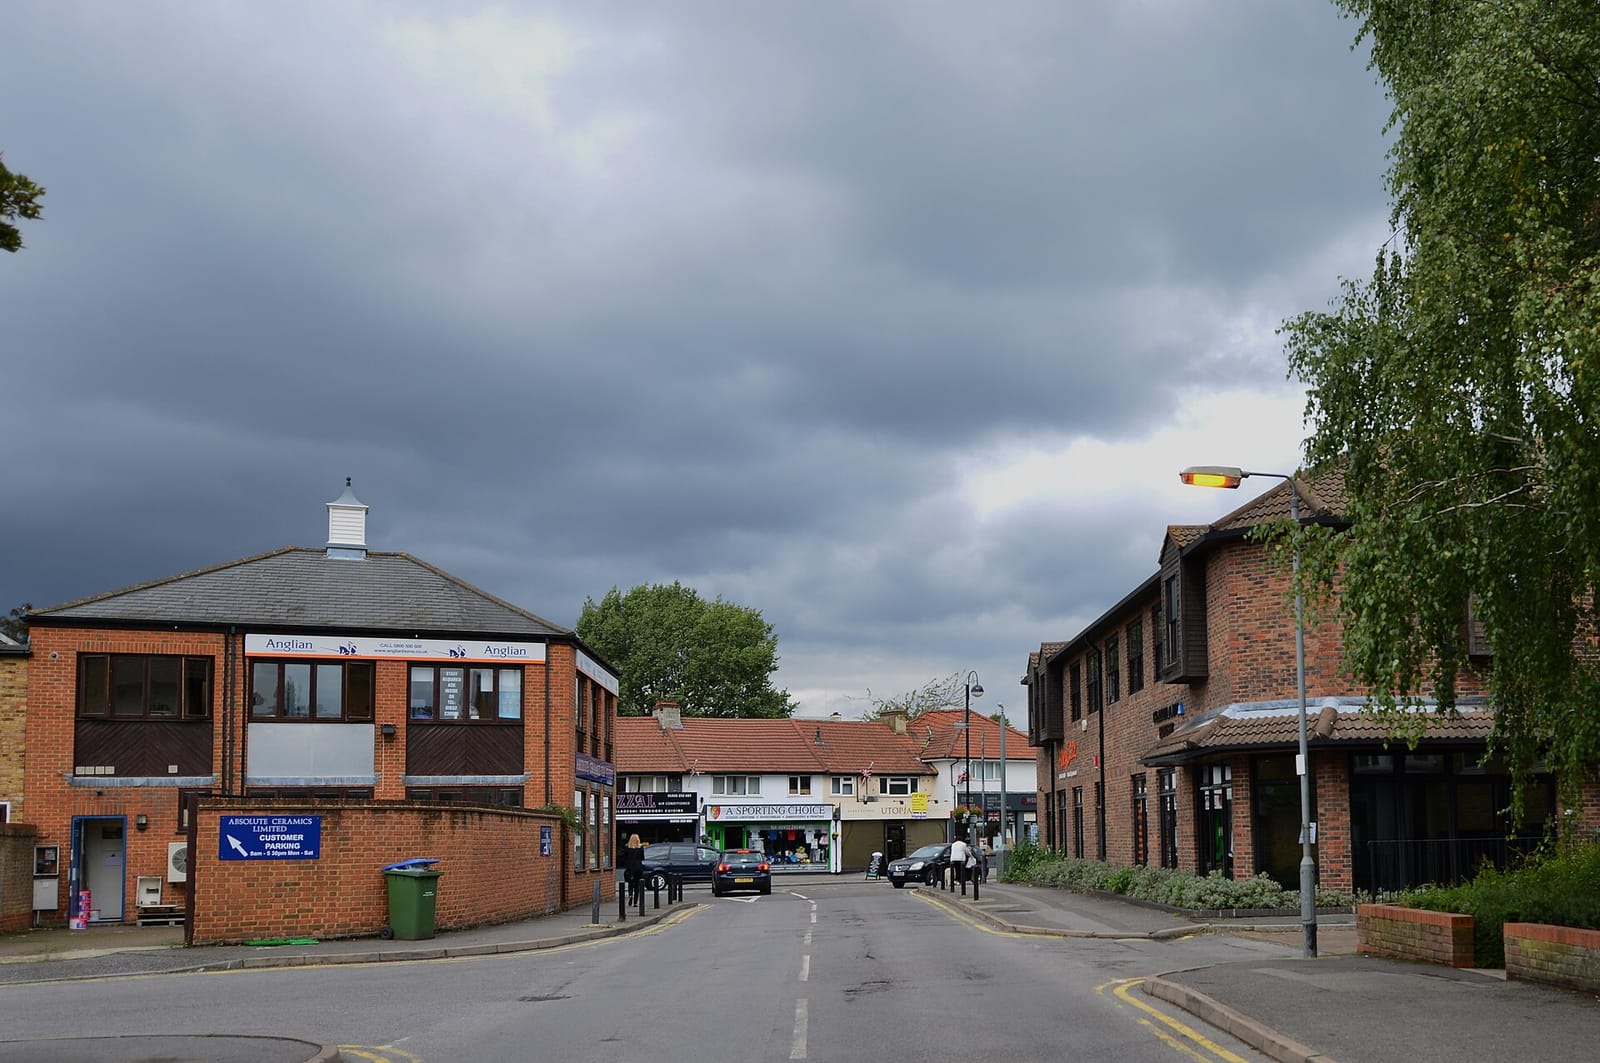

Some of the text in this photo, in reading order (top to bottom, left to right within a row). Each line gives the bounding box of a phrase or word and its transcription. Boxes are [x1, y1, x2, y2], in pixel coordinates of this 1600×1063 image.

[266, 638, 314, 652] Anglian
[484, 645, 527, 658] Anglian
[725, 806, 825, 816] A SPORTING CHOICE
[252, 825, 287, 833] LIMITED
[265, 842, 300, 850] PARKING
